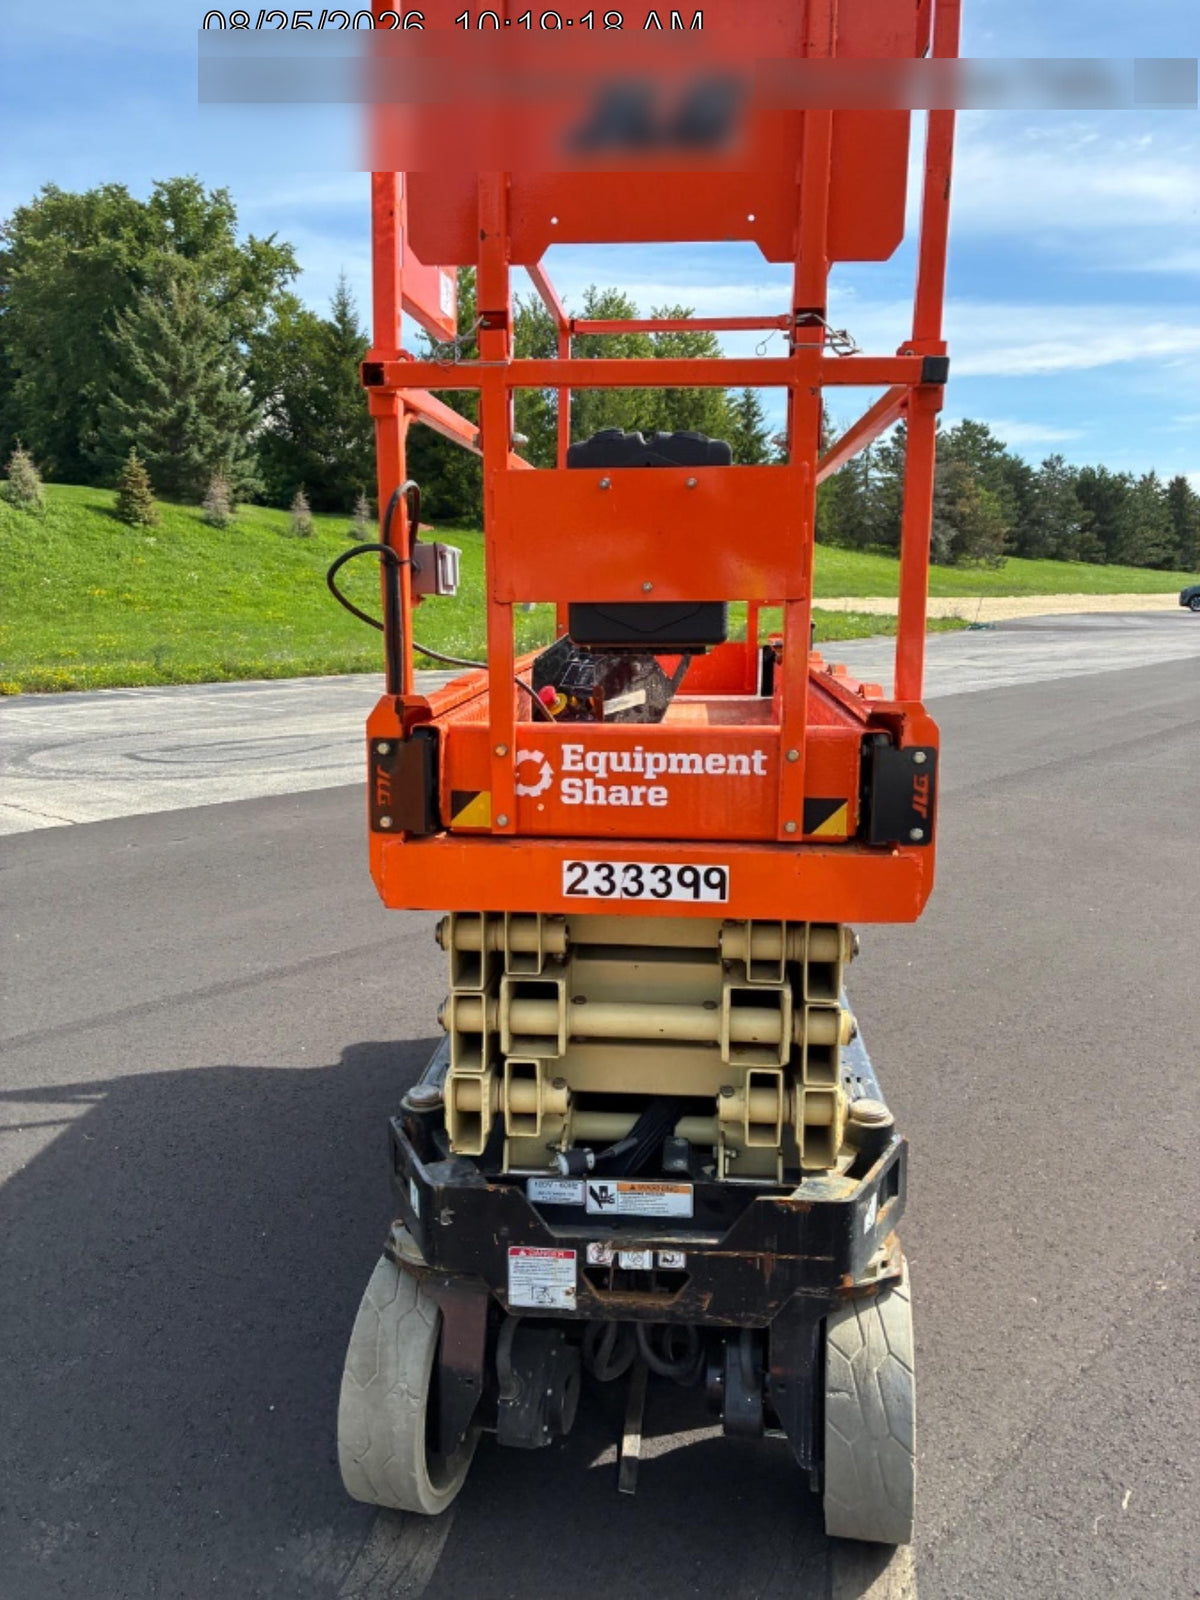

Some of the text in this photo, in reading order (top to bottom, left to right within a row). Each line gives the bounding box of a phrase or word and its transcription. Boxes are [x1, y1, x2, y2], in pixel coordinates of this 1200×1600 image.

[561, 744, 768, 779] Equipment
[376, 764, 391, 806] JLG
[560, 778, 668, 807] Share
[912, 773, 928, 819] JLG
[565, 862, 727, 900] 233399
